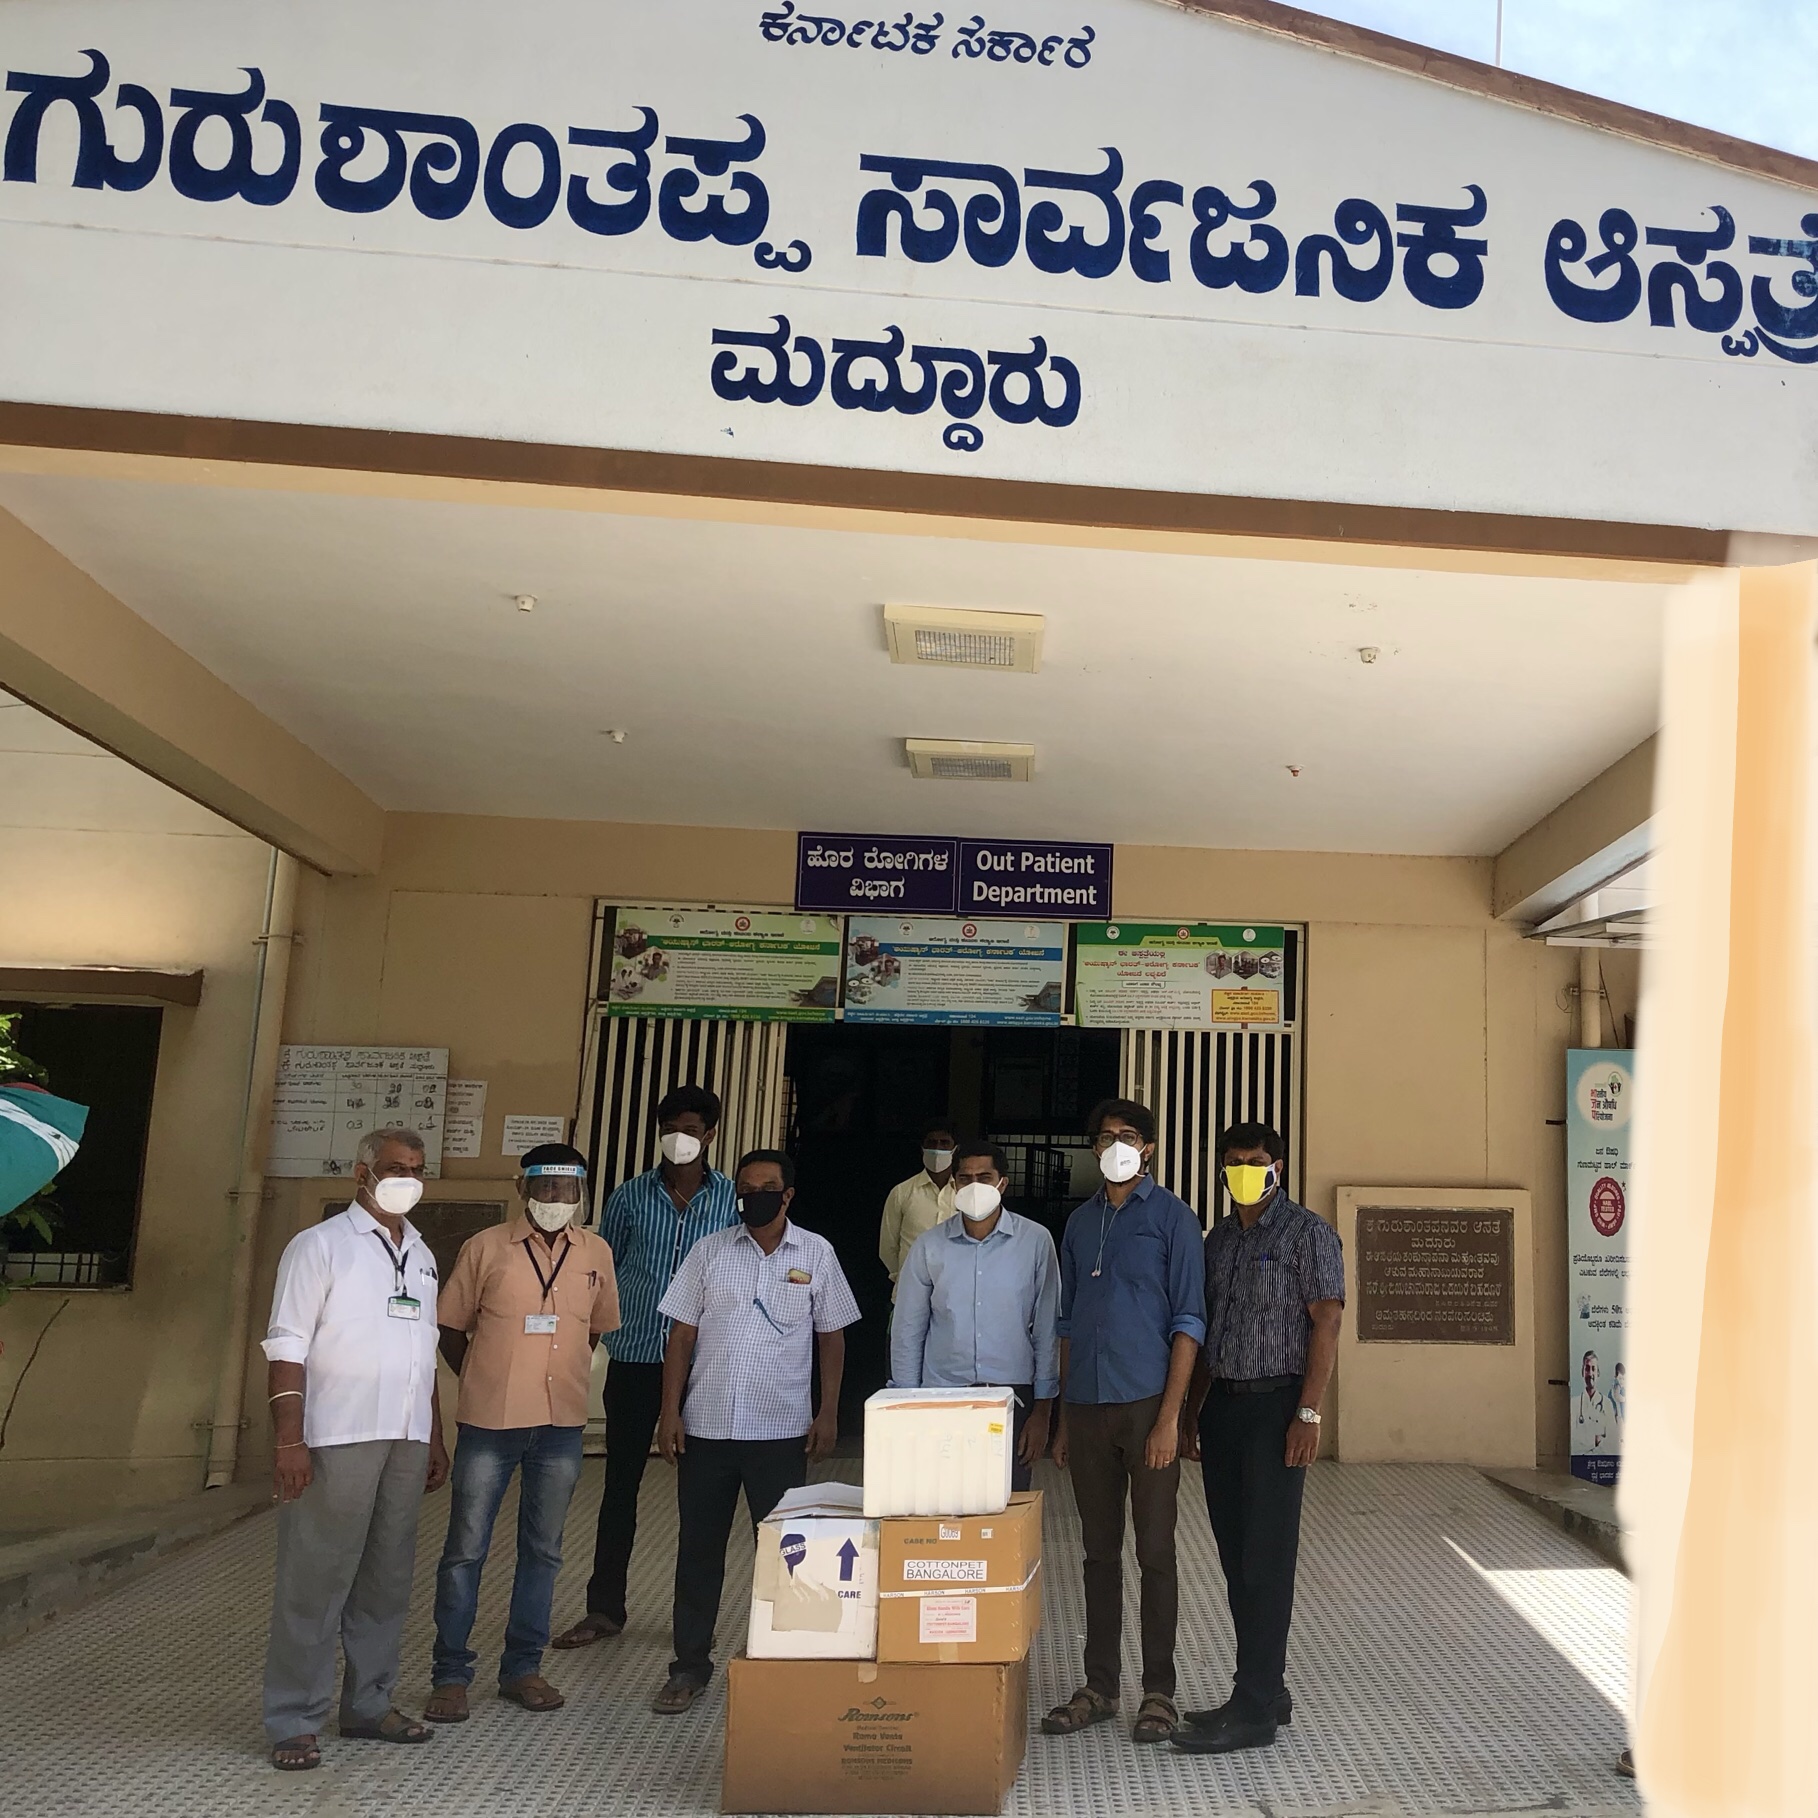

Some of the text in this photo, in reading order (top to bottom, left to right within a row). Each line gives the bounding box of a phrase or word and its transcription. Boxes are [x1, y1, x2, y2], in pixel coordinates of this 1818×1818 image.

[758, 0, 1095, 69] ಕರ್ನಾಟಕ ಸರ್ಕಾರ
[3, 48, 812, 273] ಗುರುಶಾಂತಪ್ಪ
[855, 146, 1488, 310] ಸಾರ್ವಜನಿಕ
[711, 314, 1081, 452] ಮದ್ದೂರು
[807, 845, 949, 872] ಹೊರ ರೋಗಿಗಳ
[976, 850, 1095, 874] Out Patient
[849, 876, 905, 900] ವಿಭಾಗ
[972, 881, 1097, 906] Department
[779, 1543, 806, 1556] GLASS
[906, 1569, 984, 1580] BANGALORE
[907, 1561, 984, 1569] COTTONPET
[838, 1590, 862, 1599] CARE
[838, 1708, 913, 1722] Romsons
[843, 1744, 883, 1752] Ventilator
